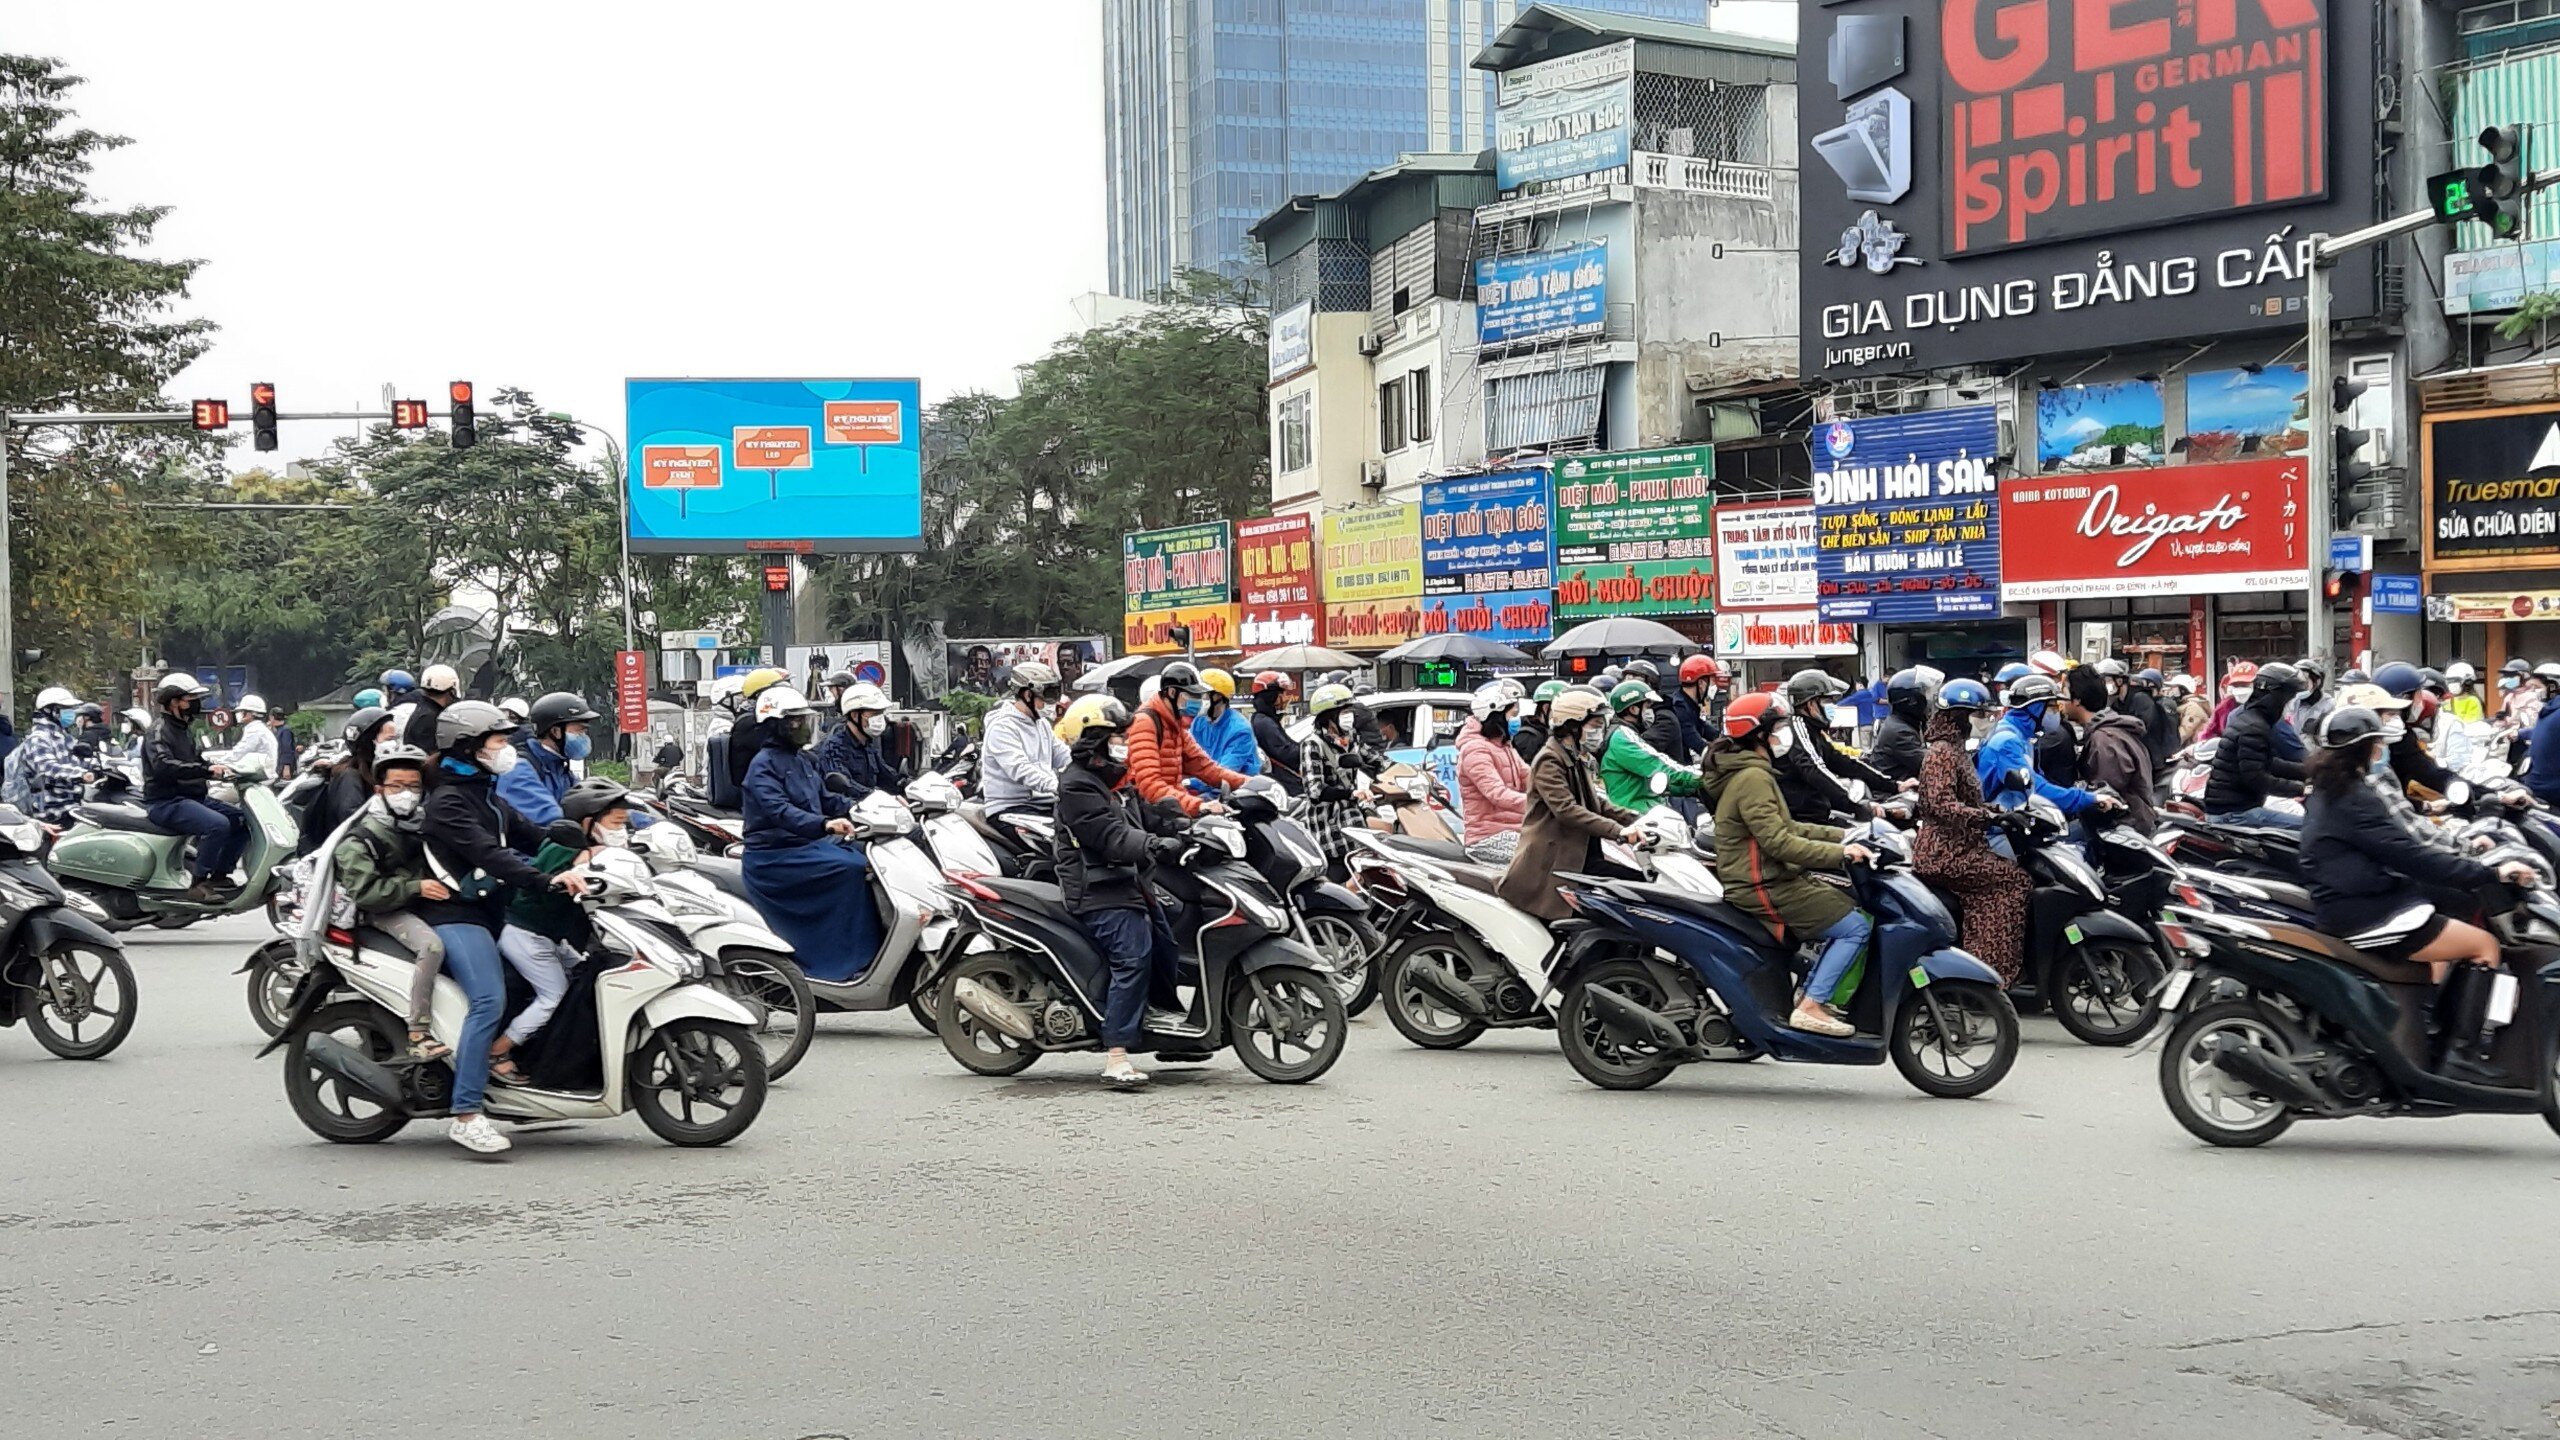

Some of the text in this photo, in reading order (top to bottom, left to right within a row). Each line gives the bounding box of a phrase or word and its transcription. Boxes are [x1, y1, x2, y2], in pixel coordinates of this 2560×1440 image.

[2135, 33, 2300, 93] GERMAN
[1963, 102, 2202, 243] spirit
[1822, 300, 1892, 339] GIA
[1905, 279, 2036, 332] DỤNG
[2052, 250, 2197, 310] ĐẲNG
[1824, 341, 1911, 369] junger.vn
[196, 403, 226, 425] 31
[396, 404, 425, 425] 31
[1559, 468, 1710, 511] DIỆT MỐI PHUN MUỖI
[1813, 448, 1996, 505] ĐỈNH HẢI SẢN
[1425, 509, 1454, 544] DIỆT
[1456, 501, 1483, 537] MỐI
[1486, 503, 1513, 539] TẬN
[1516, 496, 1546, 531] GỐC
[1904, 529, 1930, 544] SHIP
[1961, 520, 1987, 540] NHÀ
[1923, 507, 1955, 526] LẠNH
[2077, 484, 2249, 568] Origato
[2438, 509, 2470, 539] SỬA
[2474, 510, 2516, 537] CHỮA
[1722, 529, 1749, 544] TRUNG
[1752, 526, 1770, 542] TÂM
[1147, 543, 1166, 592] MỐI
[1172, 551, 1199, 590] PHUN
[1845, 551, 1870, 573] BÁN
[1874, 549, 1909, 572] BUÔN
[1948, 543, 1964, 567] LẺ
[1559, 569, 1590, 605] MỐI
[1597, 565, 1643, 603] MUỖI
[1651, 567, 1714, 606] CHUỘT
[1423, 596, 1551, 634] MỐI MUỖI CHUỘT
[1745, 615, 1777, 646] TỔNG
[1779, 623, 1800, 649] ĐẠI
[1432, 753, 1459, 766] MU
